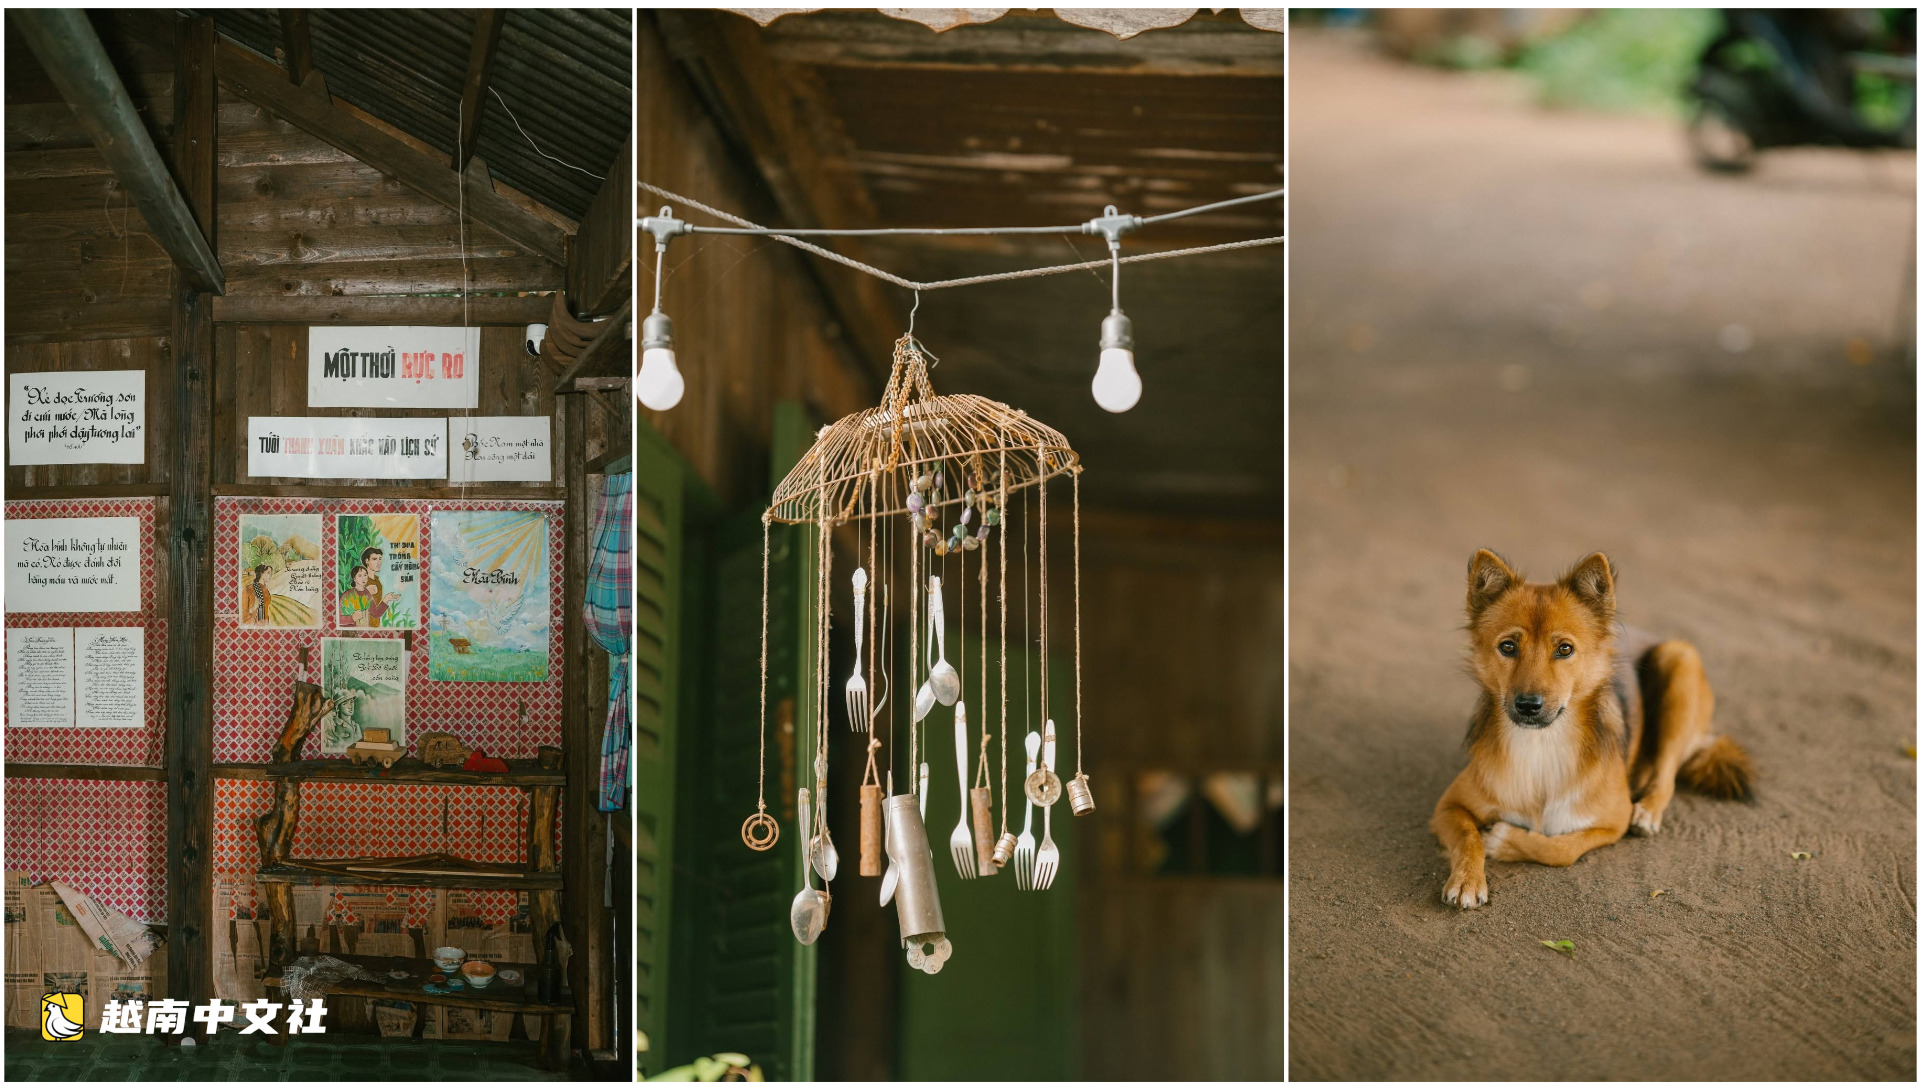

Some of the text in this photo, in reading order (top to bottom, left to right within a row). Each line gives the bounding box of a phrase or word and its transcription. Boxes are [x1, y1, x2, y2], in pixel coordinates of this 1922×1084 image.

[323, 347, 359, 382] MỘT
[360, 345, 396, 379] THỜI
[401, 350, 435, 384] RỰC
[378, 434, 397, 456] VÀO
[400, 436, 420, 459] LỊCH
[490, 568, 520, 585] Bình
